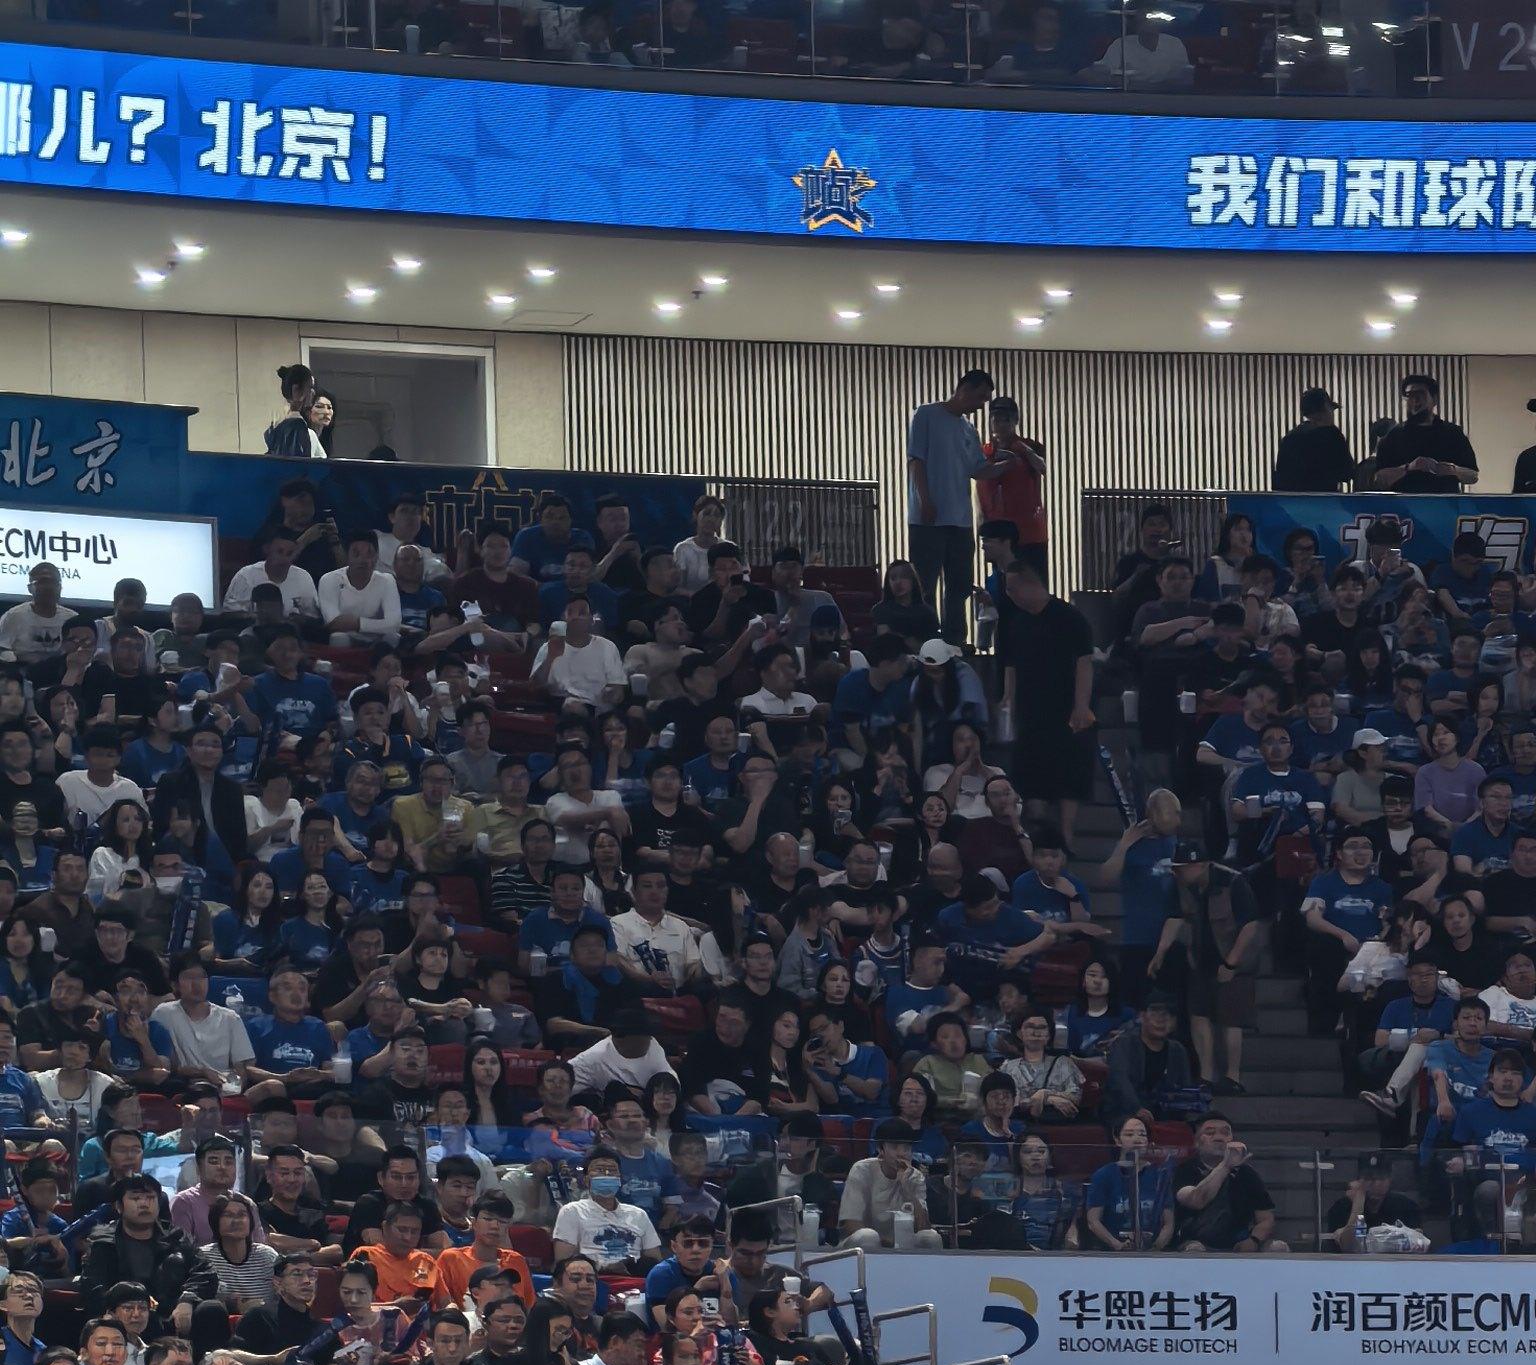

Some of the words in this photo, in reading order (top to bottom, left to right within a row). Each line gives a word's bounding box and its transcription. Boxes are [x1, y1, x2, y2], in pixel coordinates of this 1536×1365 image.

[3, 417, 121, 494] 北京
[1058, 1289, 1238, 1331] 华熙生物
[1058, 1337, 1158, 1353] BLOOMAGE
[1163, 1338, 1238, 1354] BIOTECH
[1361, 1339, 1462, 1354] BIOHYALUX
[1467, 1339, 1508, 1354] ECM
